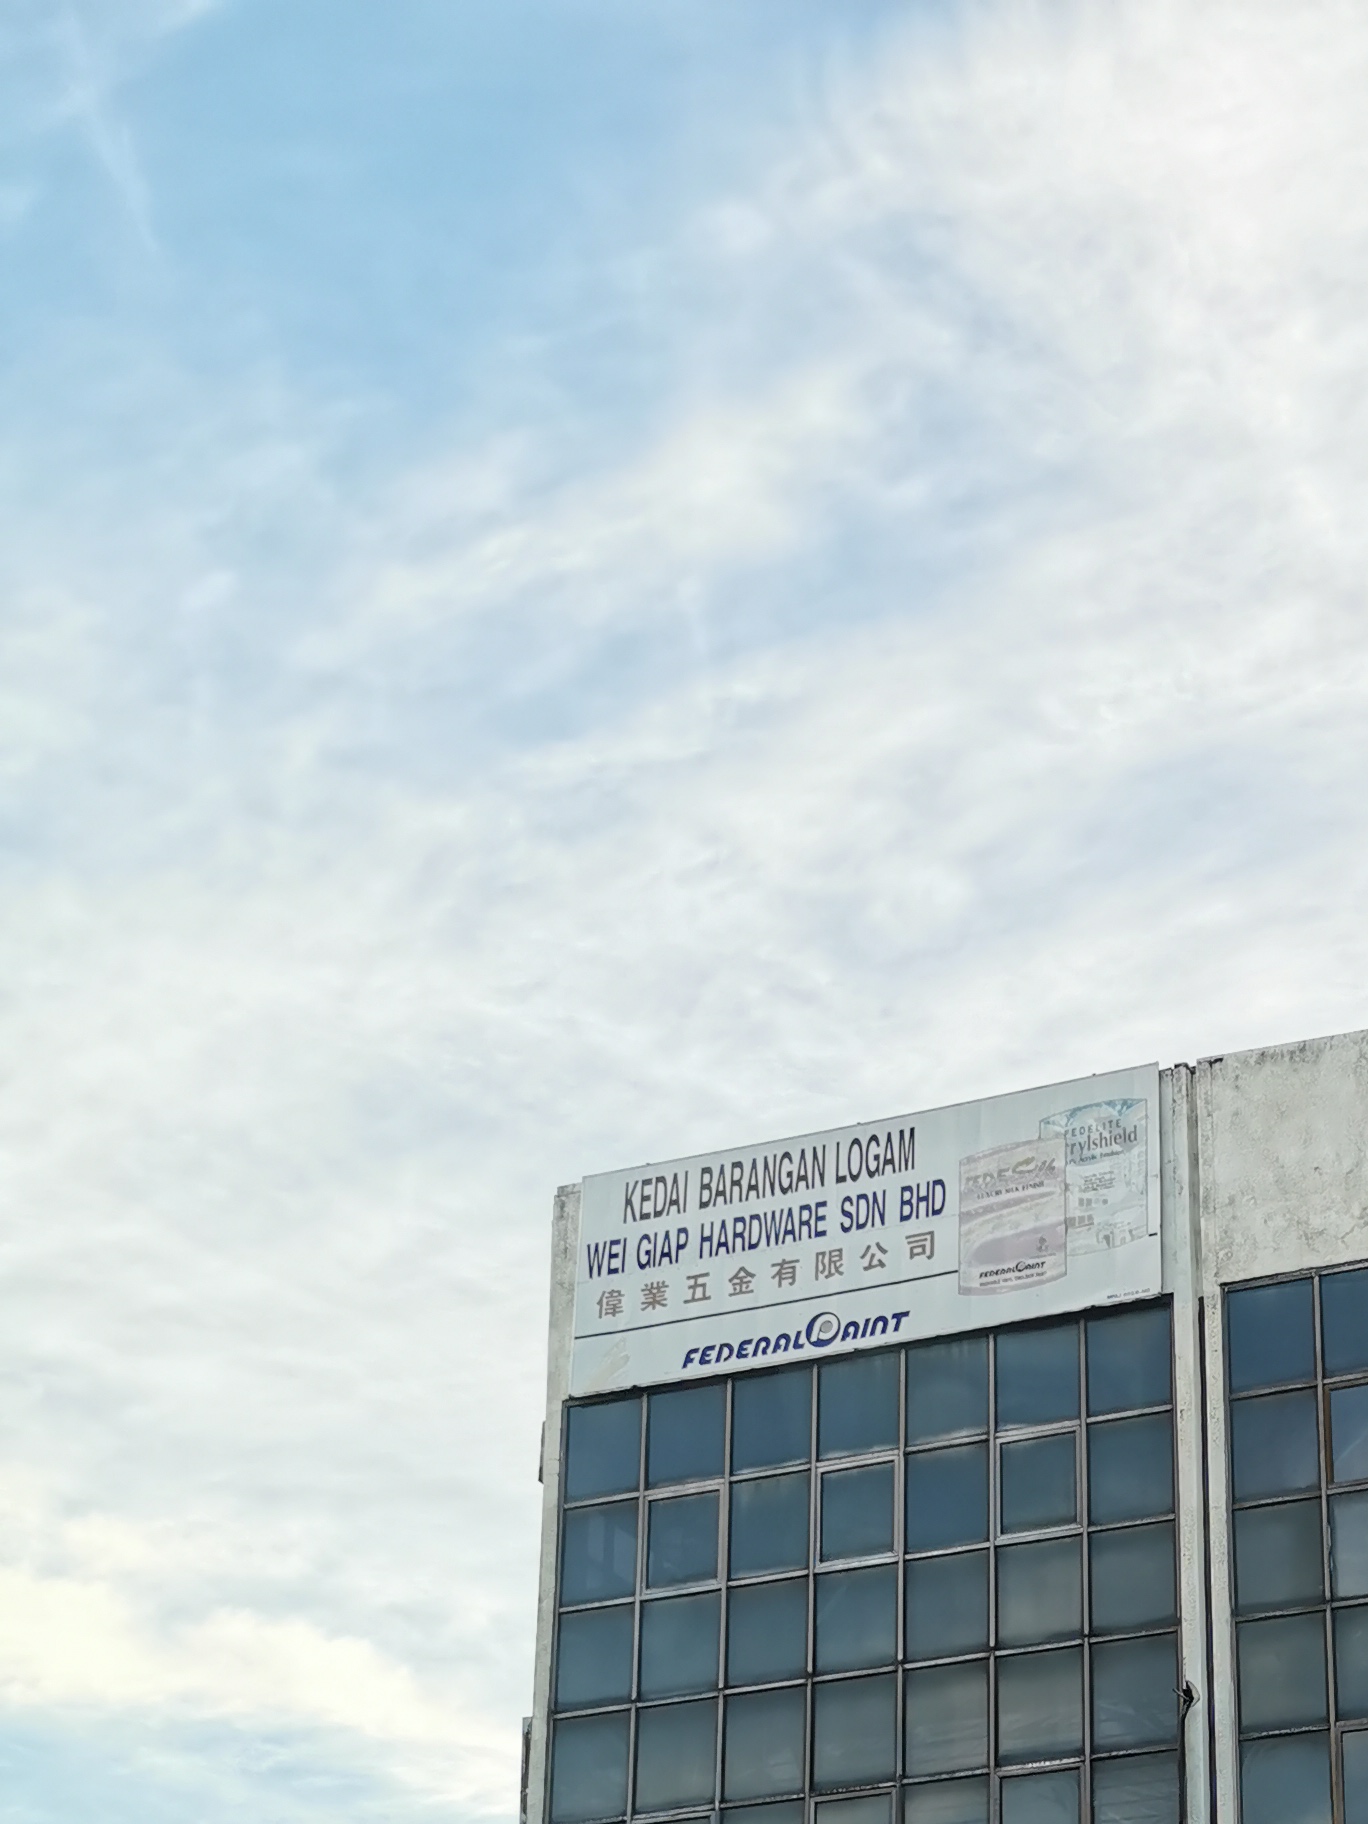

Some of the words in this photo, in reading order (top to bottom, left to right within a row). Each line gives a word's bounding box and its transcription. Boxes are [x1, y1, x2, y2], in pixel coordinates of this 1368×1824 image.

[623, 1170, 689, 1224] KEDAI
[699, 1144, 826, 1211] BARANGAN
[835, 1126, 916, 1185] LOGAM
[586, 1237, 628, 1280] WEI
[636, 1226, 689, 1271] GIAP
[699, 1200, 828, 1259] HARDWARE
[840, 1189, 887, 1234] SDN
[900, 1178, 946, 1223] BHD
[596, 1230, 936, 1319] 偉業五金有限公司
